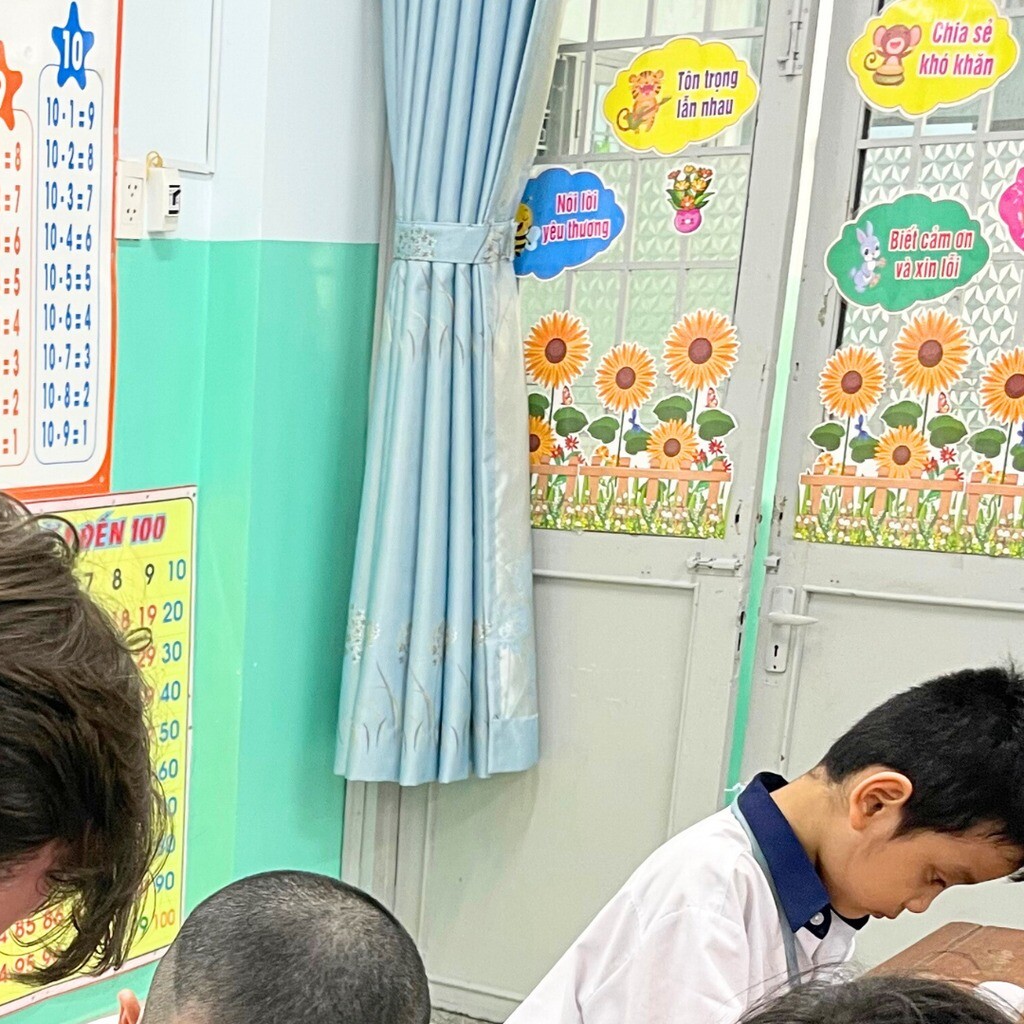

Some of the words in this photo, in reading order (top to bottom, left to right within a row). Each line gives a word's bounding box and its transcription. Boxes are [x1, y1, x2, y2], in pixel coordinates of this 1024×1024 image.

[932, 21, 969, 43] Chia
[973, 18, 993, 43] sẻ
[62, 30, 83, 71] 10
[919, 53, 949, 75] khó
[953, 53, 994, 75] khăn
[678, 70, 700, 91] Tôn
[705, 69, 739, 92] trọng
[677, 95, 697, 118] lẫn
[701, 97, 733, 117] nhau
[557, 192, 578, 213] Nói
[581, 190, 597, 211] lời
[542, 221, 564, 243] yêu
[568, 219, 610, 239] thương
[890, 226, 917, 250] Biết
[921, 226, 951, 249] cảm
[956, 230, 973, 248] ơn
[896, 257, 911, 278] và
[915, 258, 937, 278] xin
[941, 253, 959, 277] lỗi
[131, 515, 166, 543] 100
[112, 568, 122, 590] 8
[145, 563, 155, 585] 9
[168, 558, 187, 581] 10
[139, 604, 157, 628] 19
[163, 600, 184, 623] 20
[162, 640, 182, 664] 30
[160, 680, 181, 702] 40
[159, 720, 180, 742] 50
[159, 758, 179, 781] 60
[155, 871, 175, 893] 90
[154, 908, 176, 930] 100
